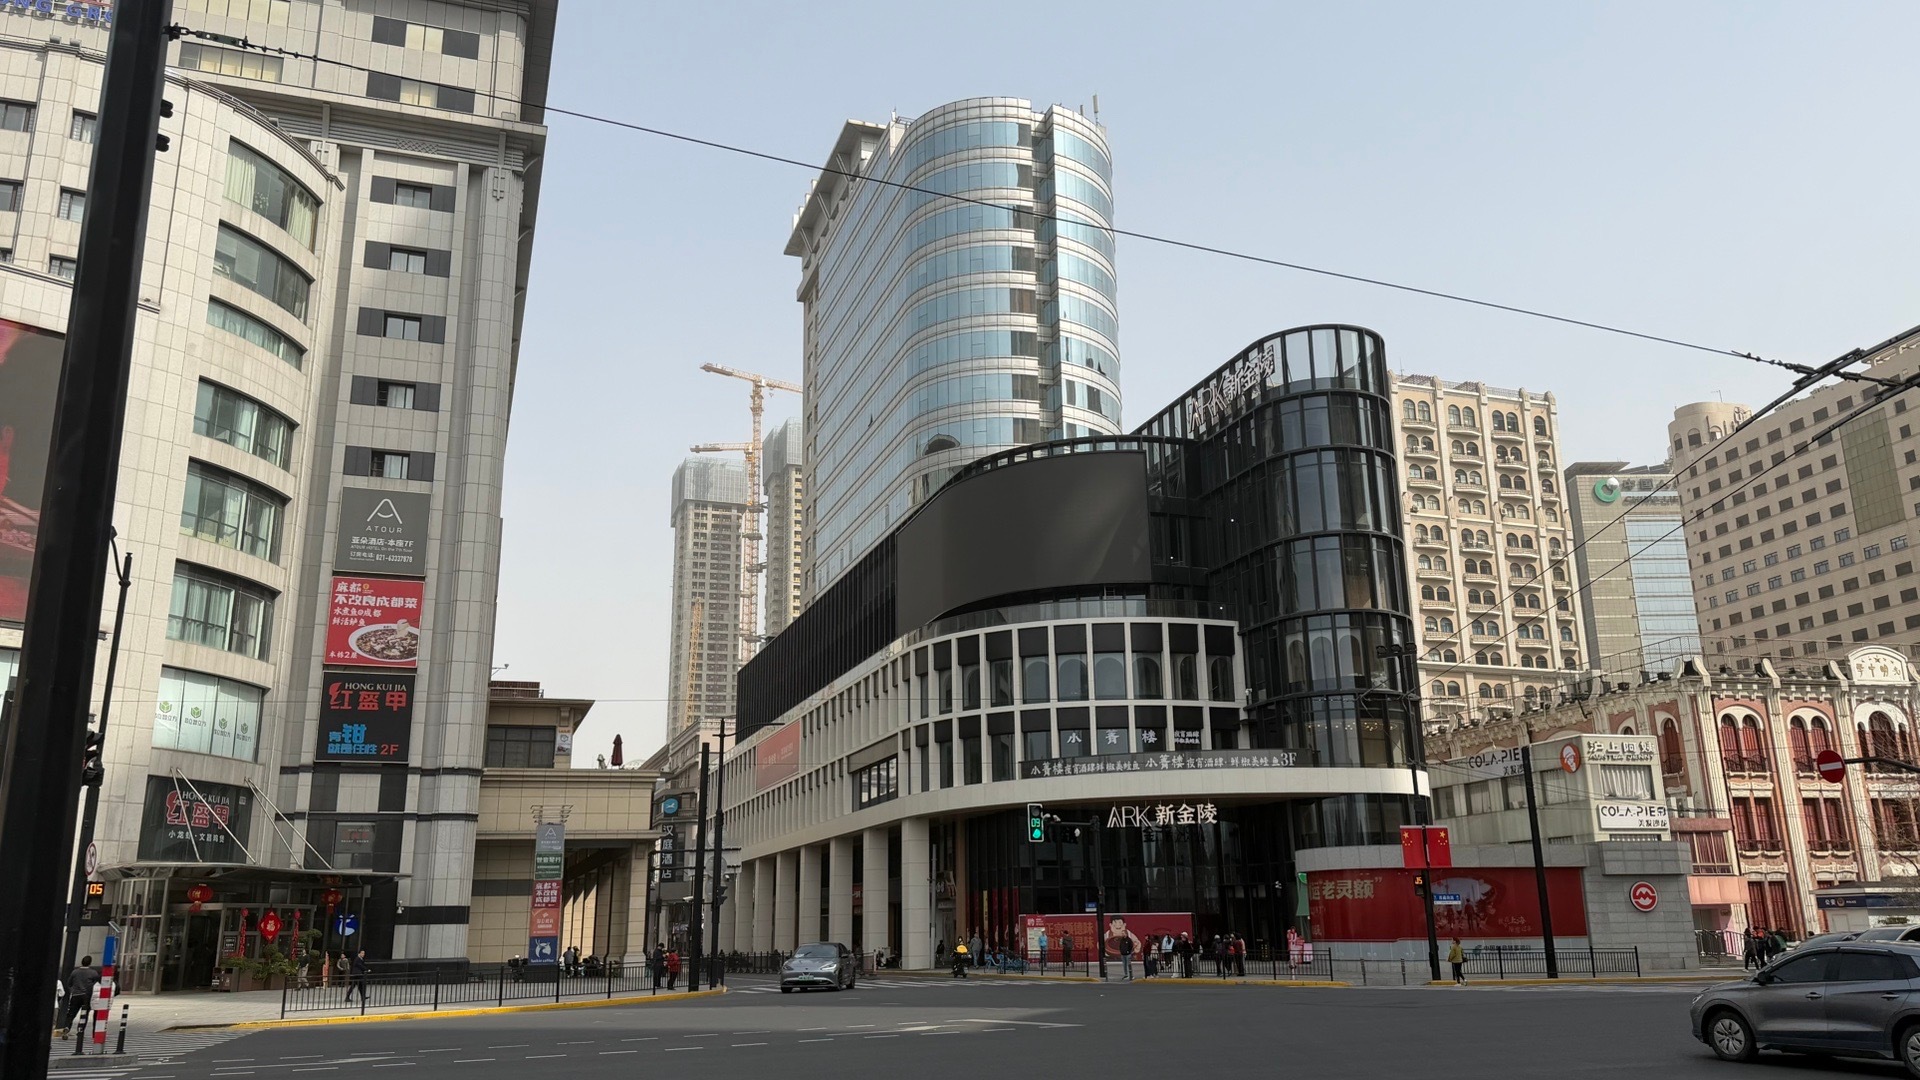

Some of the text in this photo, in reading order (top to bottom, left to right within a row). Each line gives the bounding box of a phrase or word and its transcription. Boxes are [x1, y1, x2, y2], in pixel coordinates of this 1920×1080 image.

[1222, 344, 1275, 403] 新金陵
[365, 525, 402, 534] ATOUR
[334, 593, 418, 609] 不改良成都菜
[329, 682, 407, 711] 红盔甲
[345, 682, 374, 690] HONG
[394, 684, 407, 692] JIA
[380, 744, 399, 755] 2F
[166, 790, 230, 829] 红盔甲
[1107, 803, 1218, 828] ARK 新金陵
[662, 824, 674, 879] 汉庭酒店
[89, 883, 103, 895] 05
